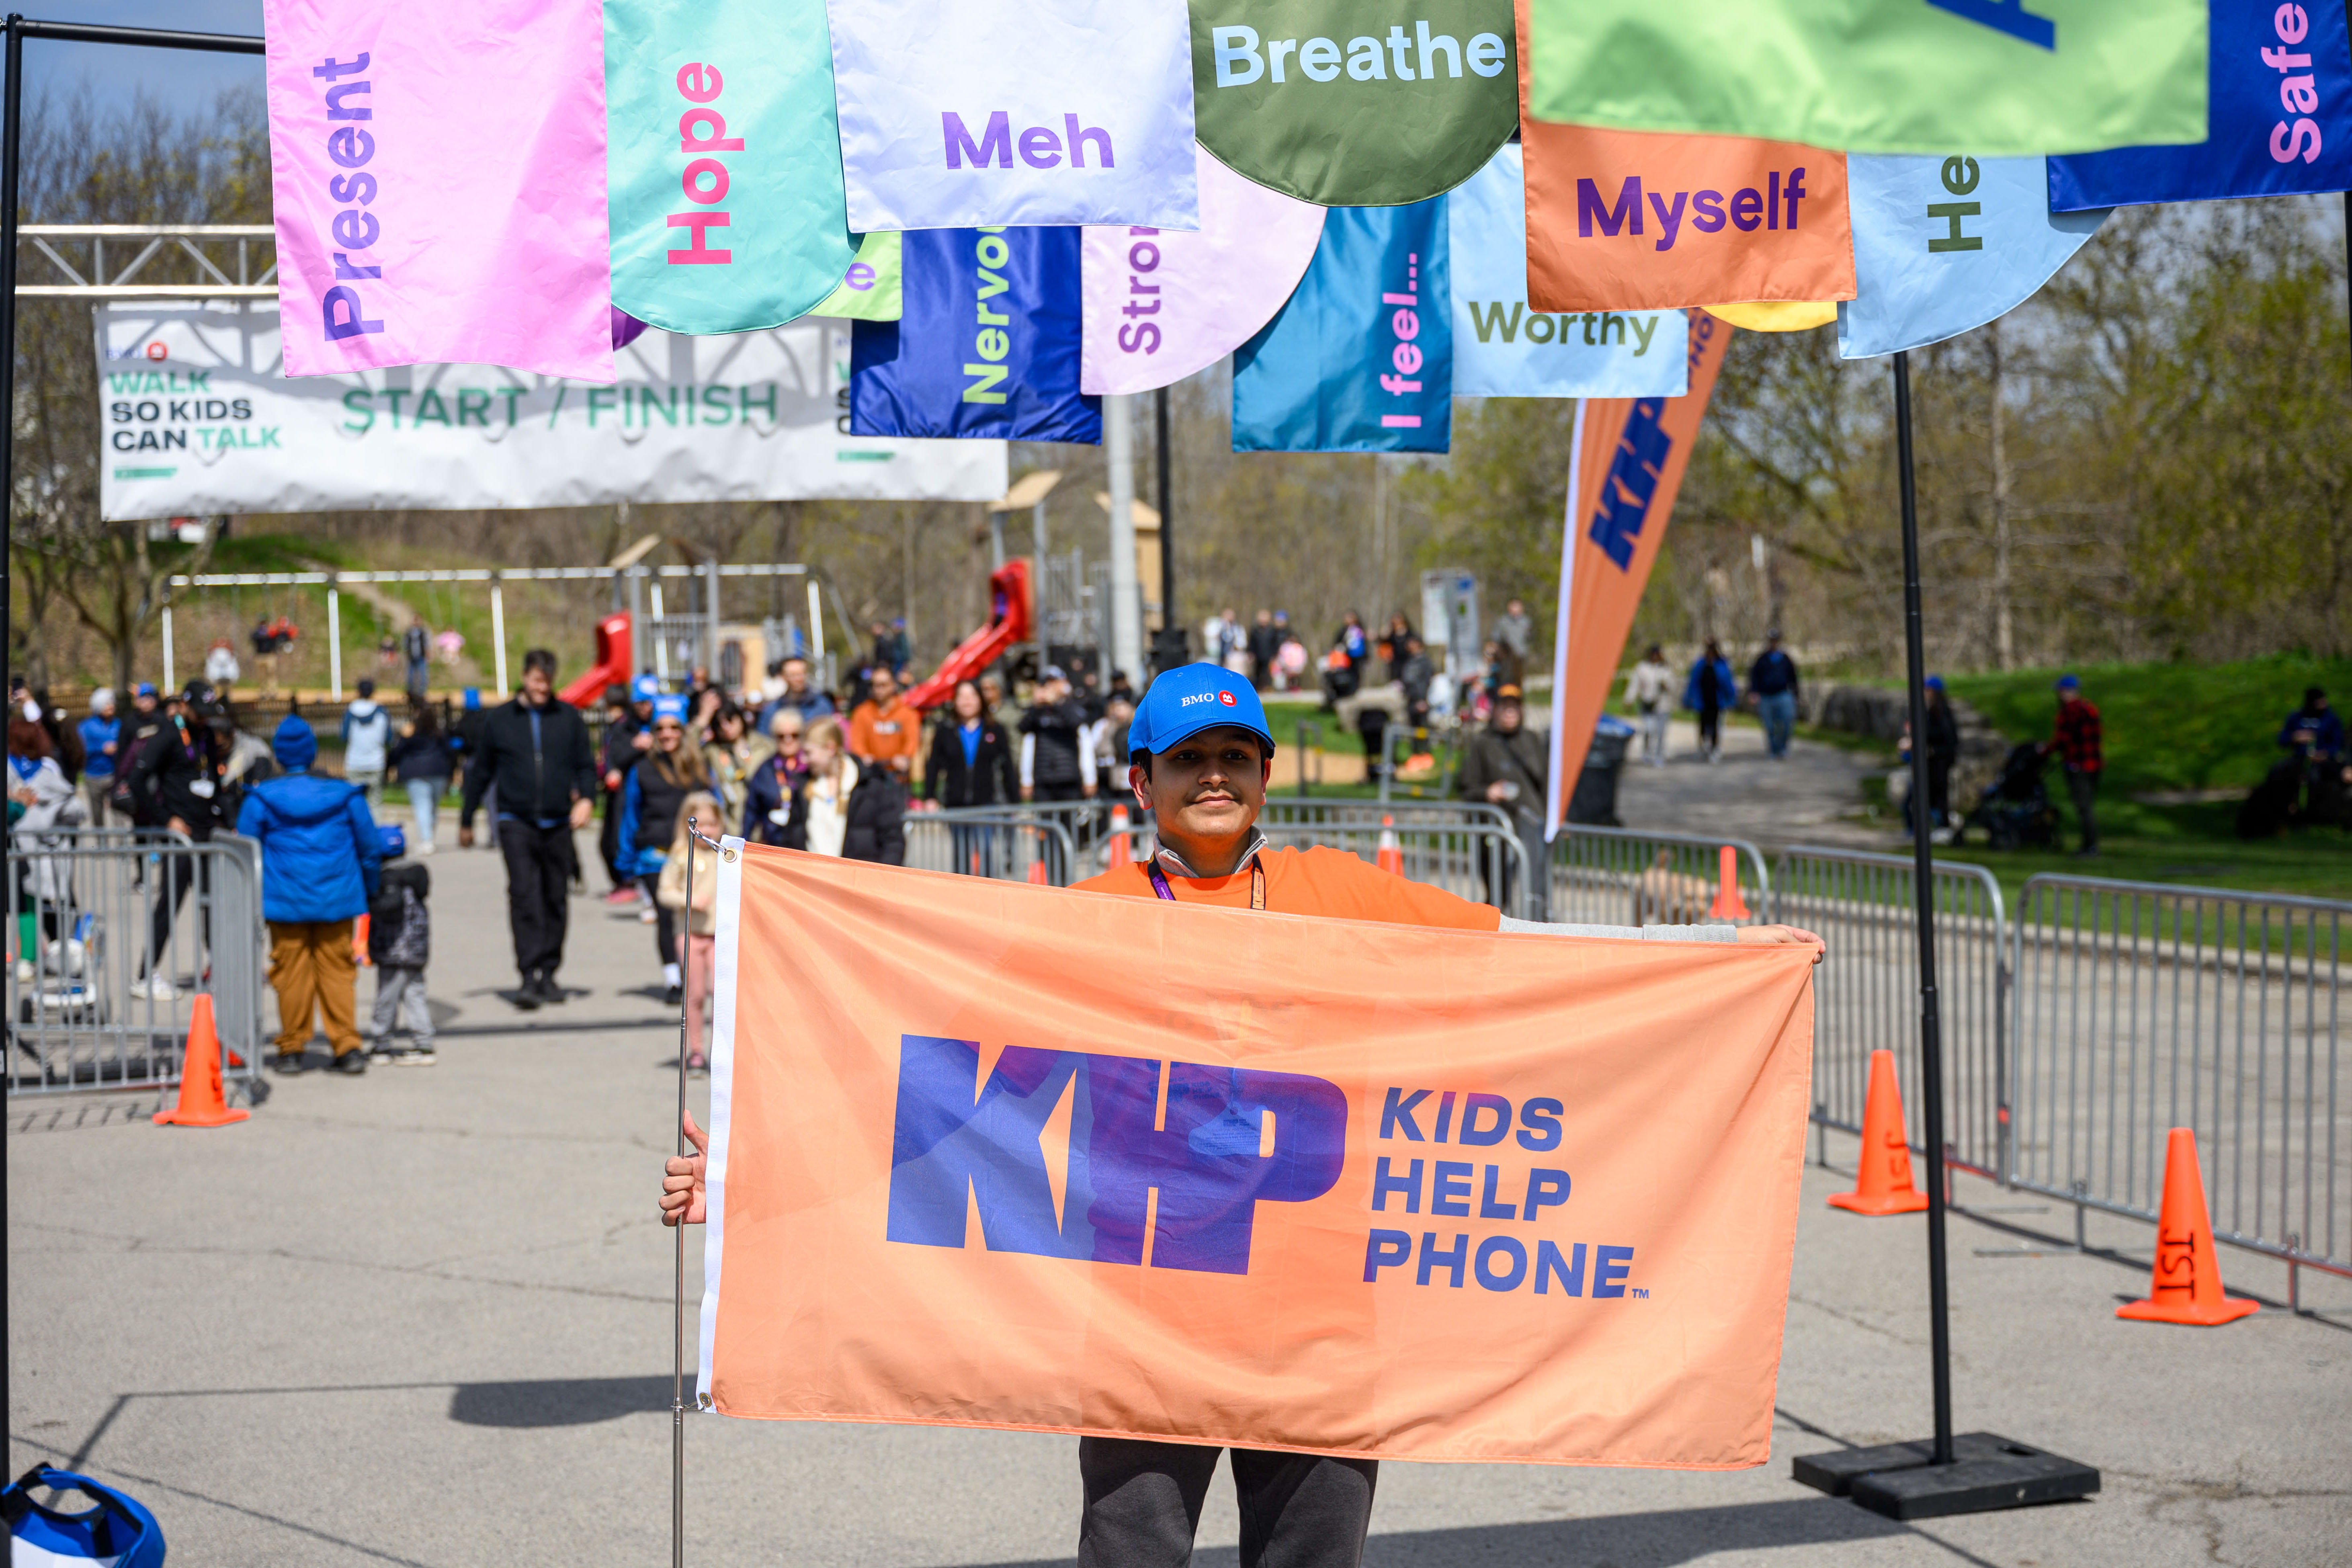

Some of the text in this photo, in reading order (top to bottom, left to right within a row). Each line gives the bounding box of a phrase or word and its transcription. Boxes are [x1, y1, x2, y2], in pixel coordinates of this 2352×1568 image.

[1212, 20, 1506, 88] Breathe
[2261, 3, 2322, 165] Safe
[667, 61, 744, 265] Hope
[941, 111, 1114, 170] Meh
[313, 51, 384, 342] Present
[1576, 168, 1806, 251] Myself
[1928, 154, 1982, 253] He
[963, 226, 1009, 404] Nervo
[1119, 227, 1161, 355] Stro
[1469, 302, 1659, 357] Worthy
[109, 371, 211, 394] WALK
[111, 399, 252, 422] SO KIDS
[342, 386, 527, 433] START
[588, 383, 779, 428] FINISH
[113, 426, 281, 451] CAN TALK
[1381, 414, 1422, 428] I
[1181, 693, 1214, 707] BMO
[1378, 1087, 1564, 1152] KIDS
[886, 1034, 1347, 1276] KHP
[1370, 1156, 1572, 1222] HELP
[1363, 1229, 1634, 1299] PHONE
